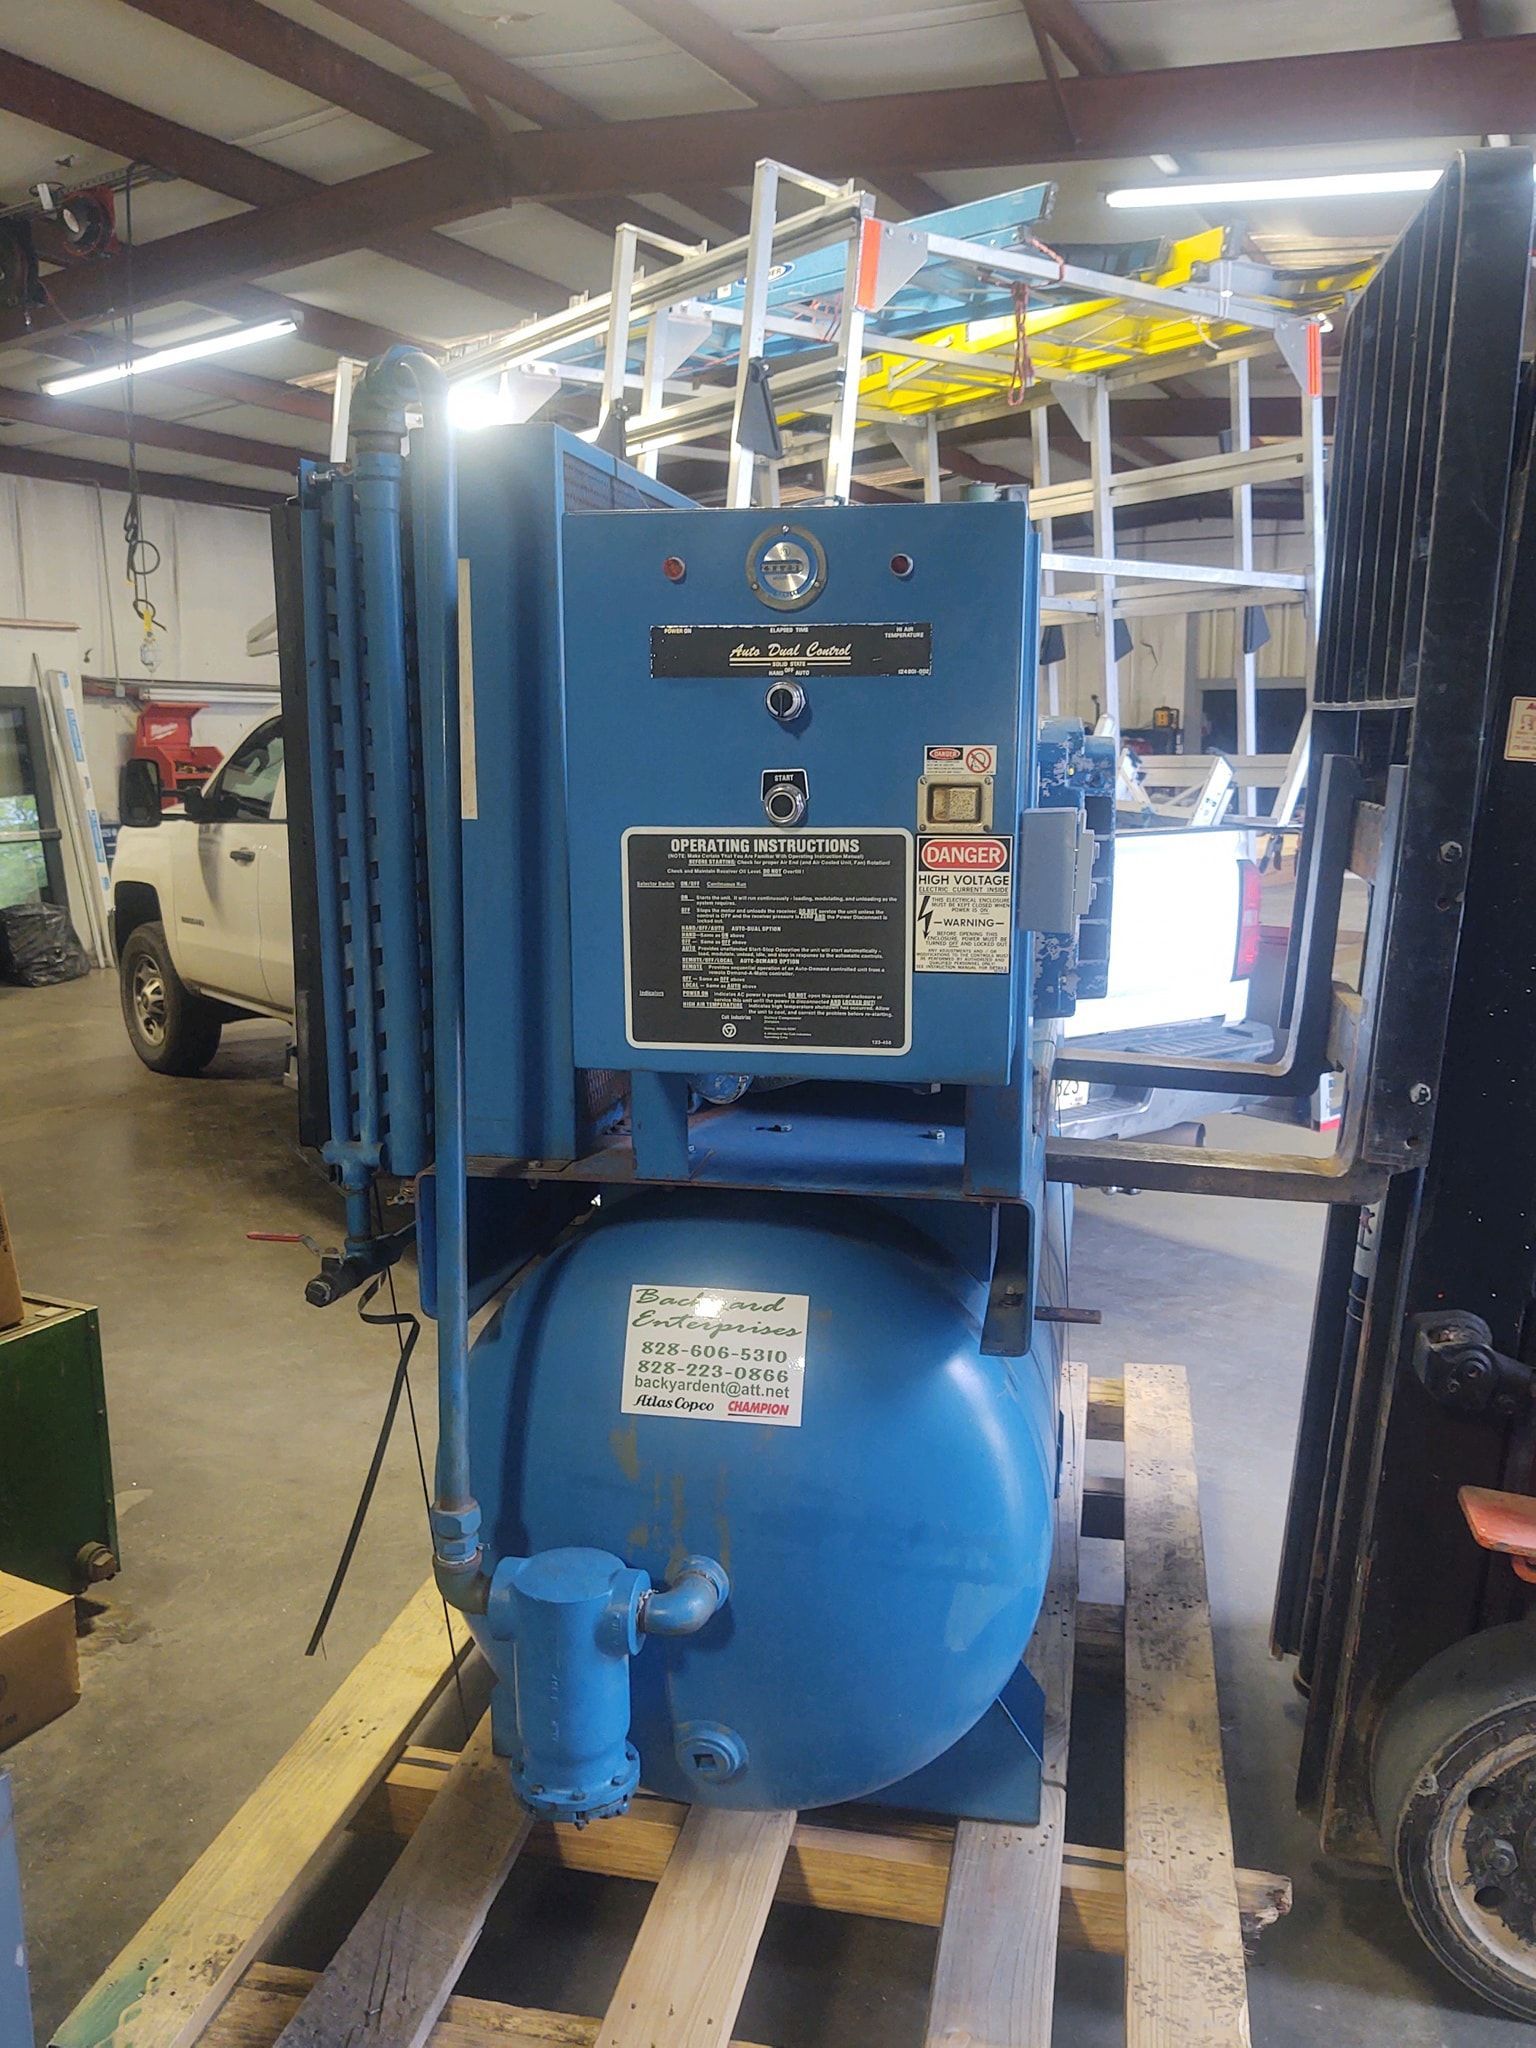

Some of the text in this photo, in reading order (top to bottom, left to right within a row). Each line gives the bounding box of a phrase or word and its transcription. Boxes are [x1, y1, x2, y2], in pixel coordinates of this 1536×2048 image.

[730, 642, 852, 657] Auto Dual Control
[774, 774, 794, 782] START
[671, 838, 860, 853] OPERATING INSTRUCTIONS
[927, 846, 1000, 863] DANGER
[919, 875, 1009, 886] HIGH VOLTAGE
[632, 1310, 802, 1339] Enterprises
[641, 1341, 788, 1363] 828-606-5310
[637, 1360, 788, 1383] 828-223-0866
[634, 1375, 789, 1399] backyardent@att.net
[633, 1394, 714, 1412] Atlas Copco
[728, 1400, 789, 1416] CHAMPION
